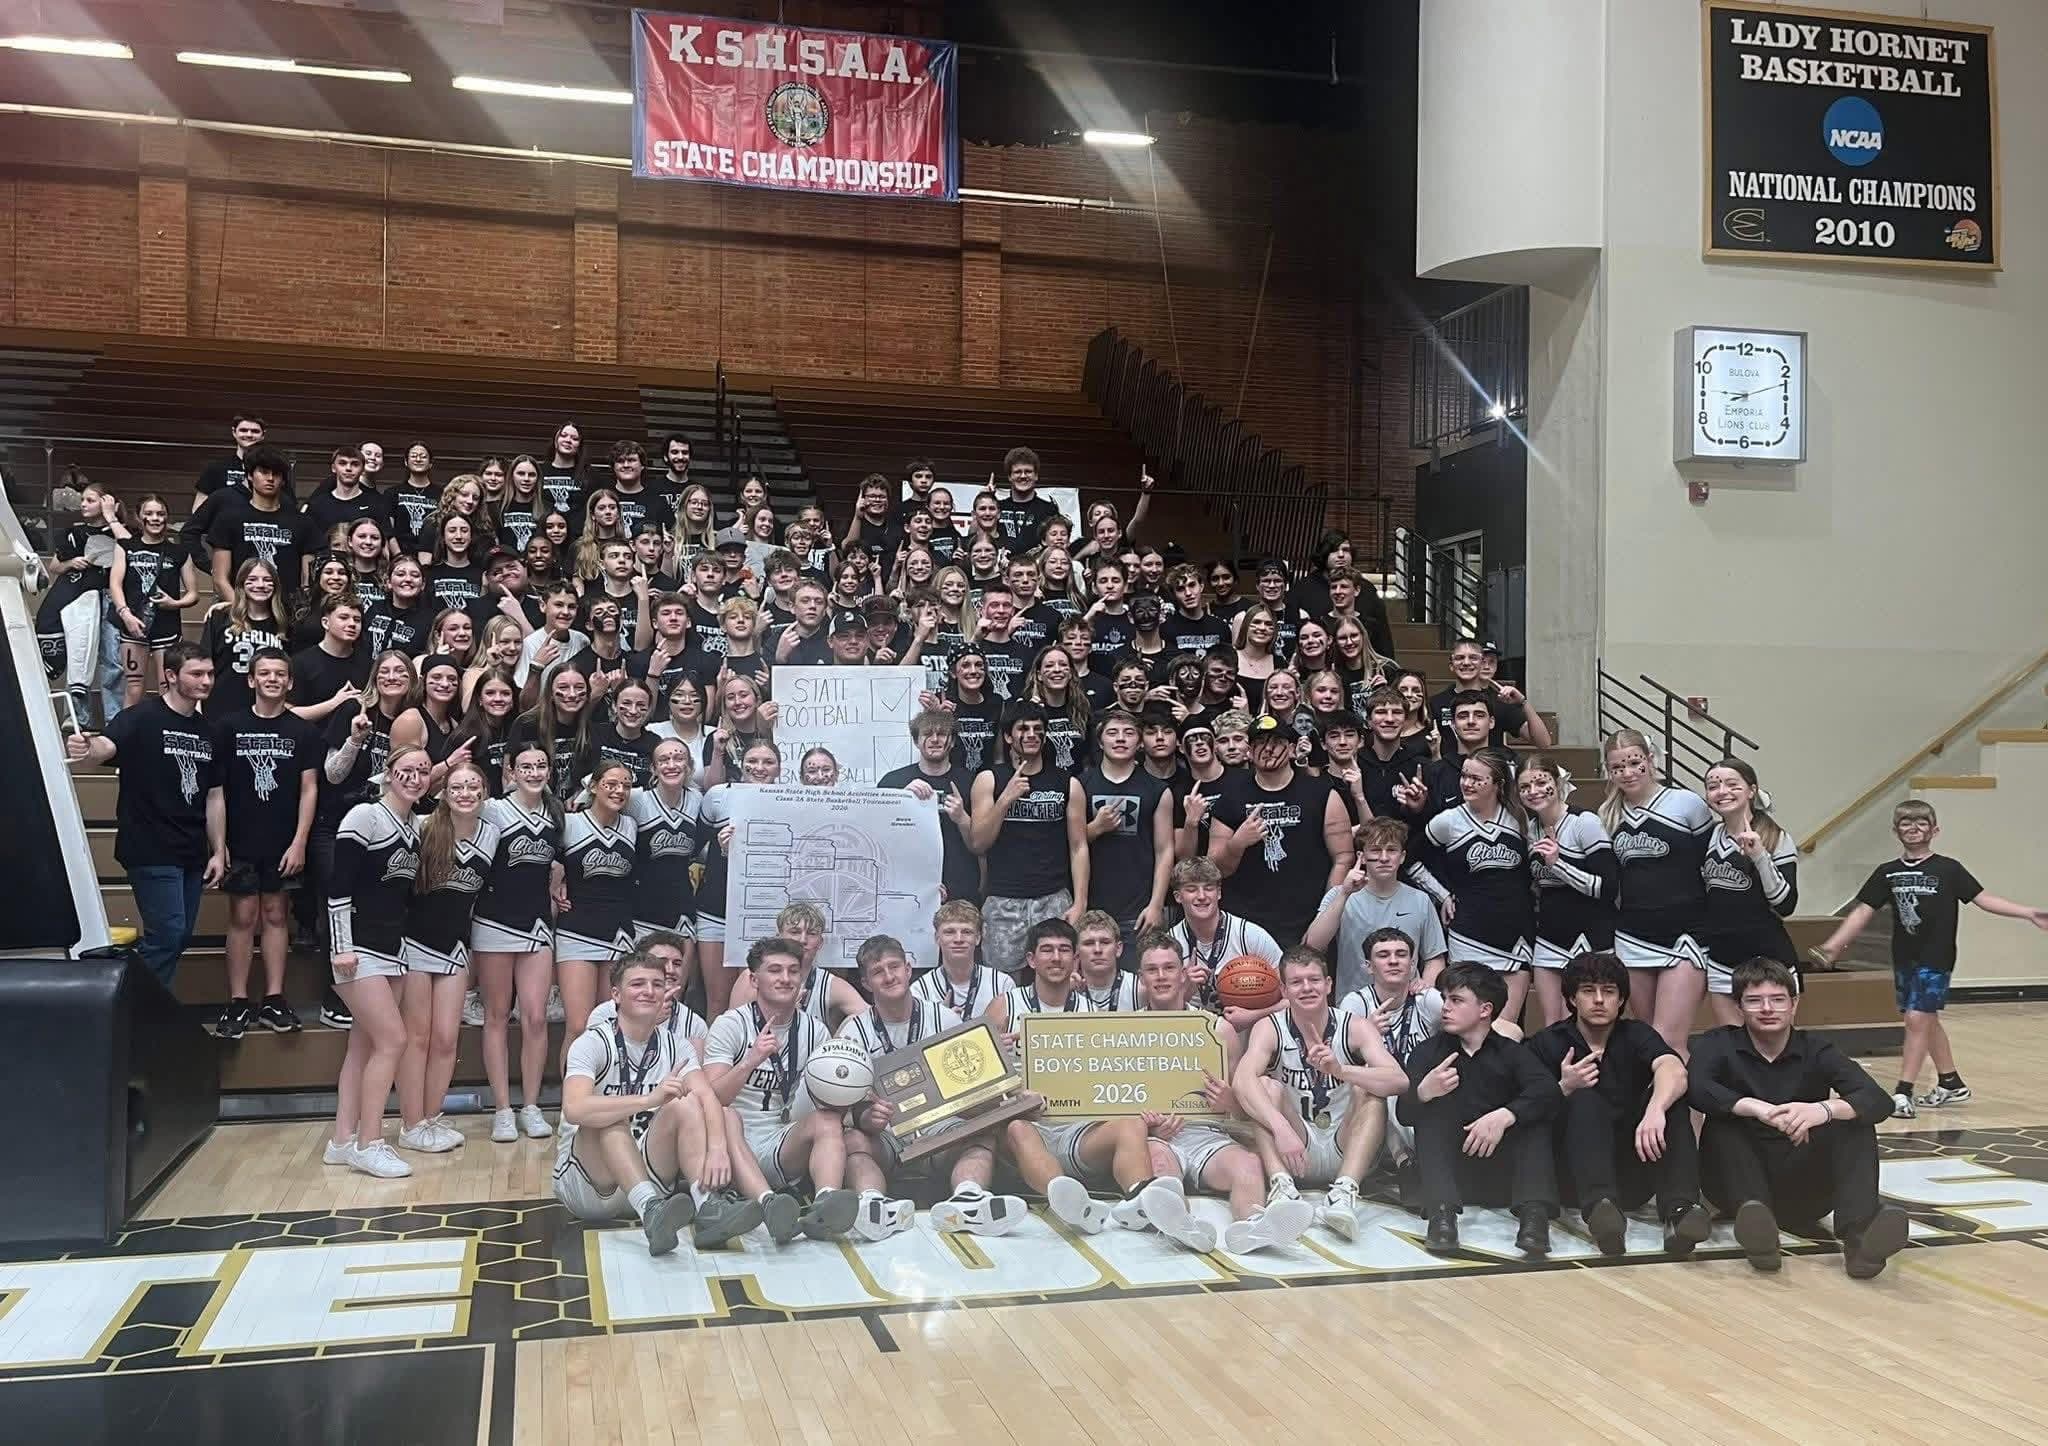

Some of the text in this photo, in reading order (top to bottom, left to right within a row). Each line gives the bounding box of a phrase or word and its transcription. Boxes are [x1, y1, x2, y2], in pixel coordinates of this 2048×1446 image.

[1730, 18, 1969, 65] LADY HORNET
[669, 24, 922, 85] K.S.H.S.A.A.
[1740, 54, 1961, 97] BASKETBALL
[1830, 129, 1882, 150] NCAA
[653, 140, 939, 190] STATE CHAMPIONSHIP
[1729, 170, 1976, 212] NATIONAL CHAMPIONS
[1815, 218, 1895, 247] 2010
[1737, 343, 1753, 356] 12
[1695, 361, 1712, 374] 10
[1781, 365, 1790, 378] 2
[1698, 411, 1708, 424] 8
[1780, 417, 1790, 429] 4
[1739, 436, 1749, 449] 6
[696, 624, 725, 635] STERL
[792, 677, 849, 703] STATE
[776, 704, 864, 729] FOOTBALL
[163, 735, 213, 752] State
[236, 738, 295, 750] State
[236, 748, 294, 757] BASKETBALL
[1030, 1032, 1205, 1049] STATE CHAMPIONS
[821, 1044, 867, 1062] SPALDING
[1034, 1056, 1203, 1073] BOYS BASKETBALL
[1092, 1083, 1148, 1104] 2026
[1050, 1100, 1081, 1108] MMTH
